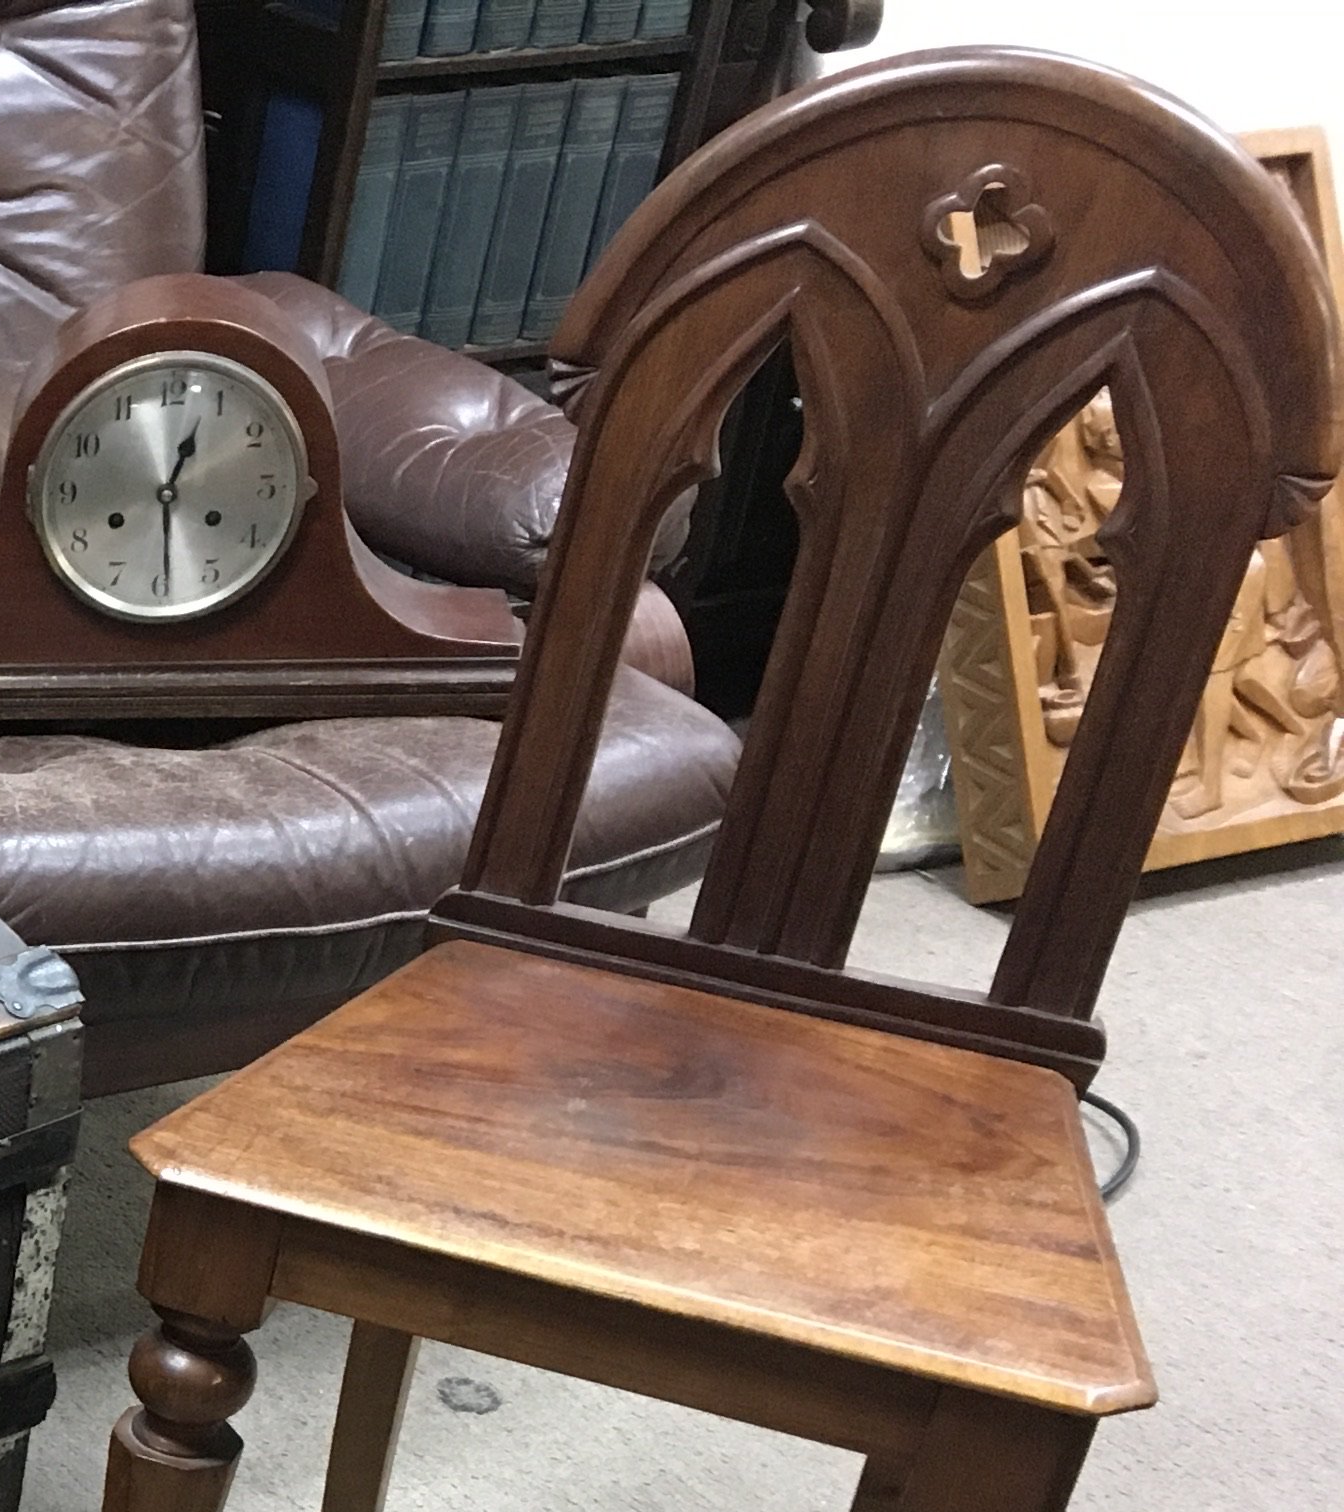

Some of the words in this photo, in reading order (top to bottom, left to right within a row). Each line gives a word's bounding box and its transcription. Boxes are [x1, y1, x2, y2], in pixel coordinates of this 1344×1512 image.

[160, 380, 188, 407] 12
[216, 389, 224, 417] 1
[115, 395, 132, 421] 11
[75, 432, 100, 458] 10
[246, 421, 263, 448] 2
[59, 480, 78, 505] 9
[257, 474, 276, 500] 3
[70, 528, 88, 553] 8
[240, 523, 261, 549] 4
[109, 561, 127, 587] 7
[201, 558, 220, 584] 5
[151, 573, 170, 598] 6
